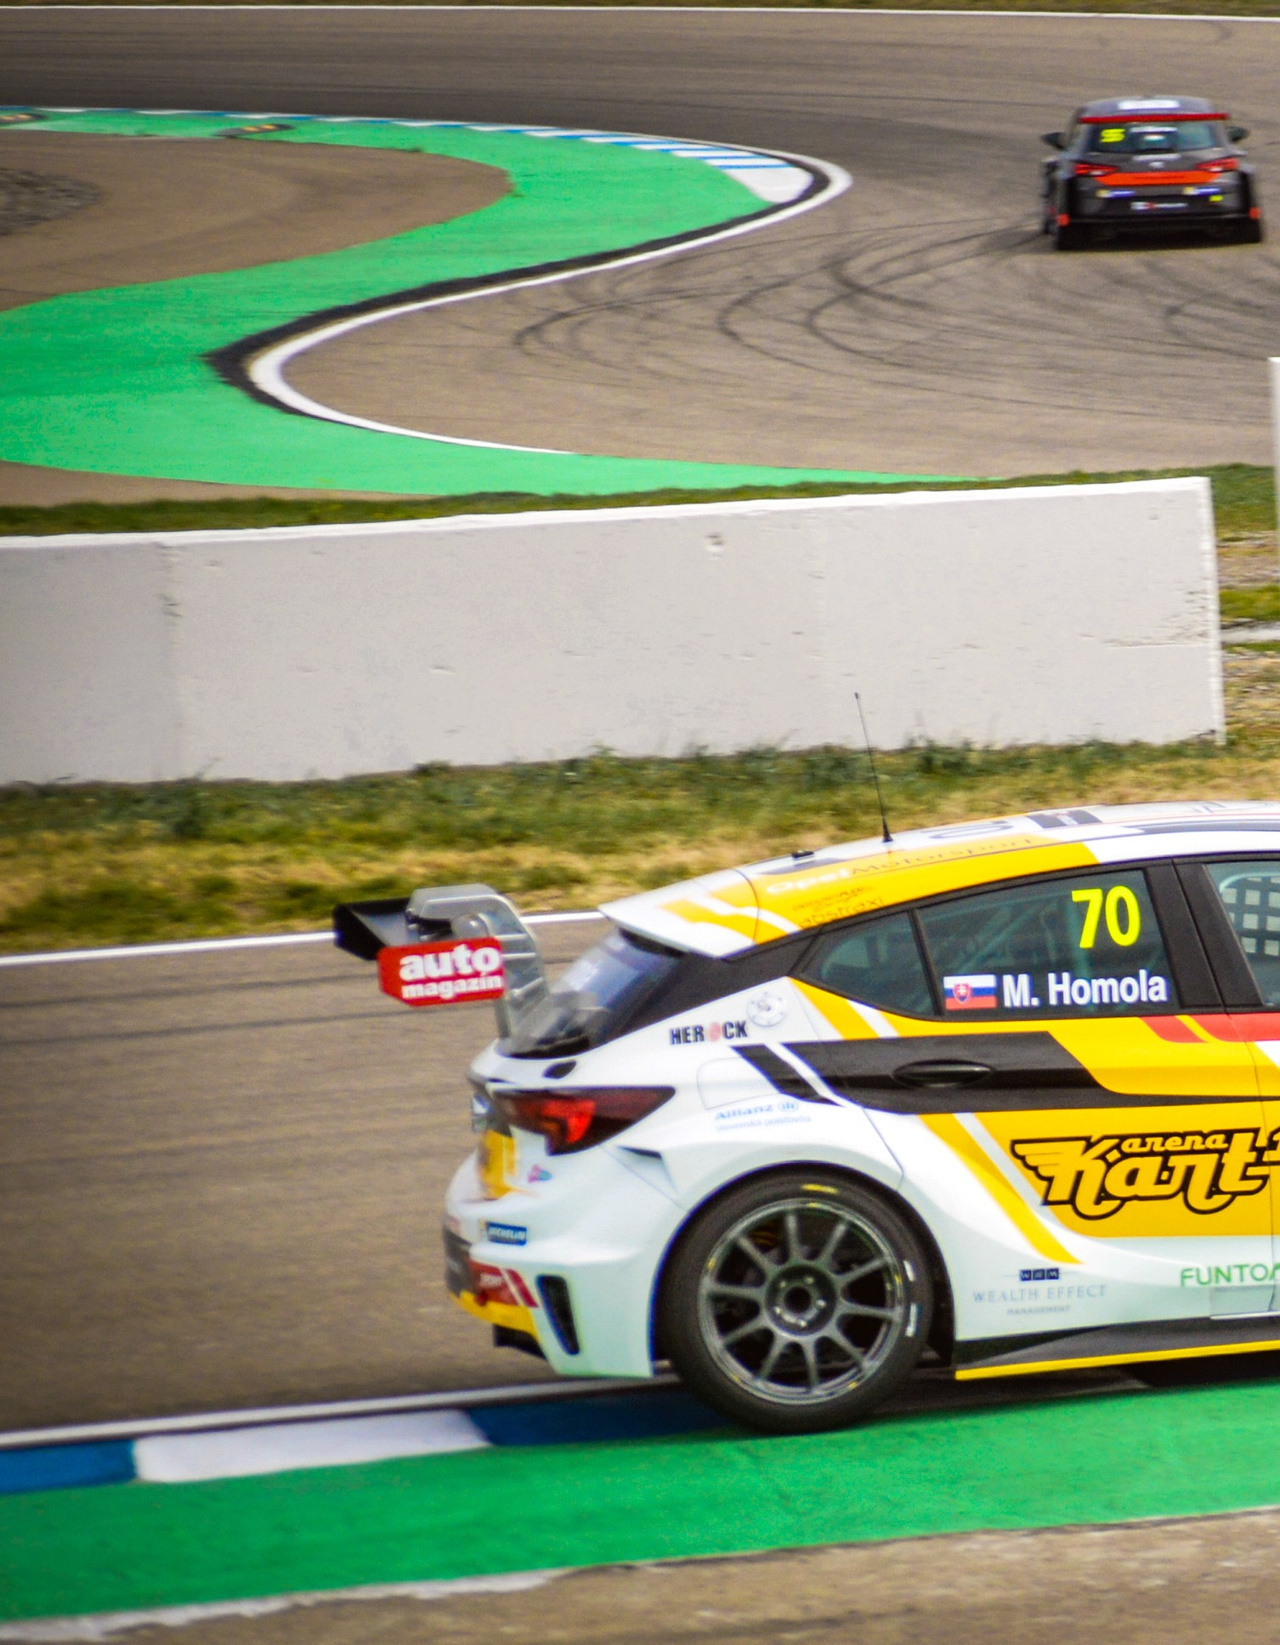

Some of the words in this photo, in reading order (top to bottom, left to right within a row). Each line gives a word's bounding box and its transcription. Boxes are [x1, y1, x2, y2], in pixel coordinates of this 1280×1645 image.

[1071, 885, 1141, 949] 70
[399, 944, 501, 981] auto
[1003, 973, 1040, 1009] M.
[1049, 968, 1169, 1005] Homola
[715, 1105, 773, 1120] Allianz
[1120, 1132, 1230, 1154] arena
[973, 1287, 1038, 1302] WEALTH
[1047, 1284, 1107, 1300] EFFECT
